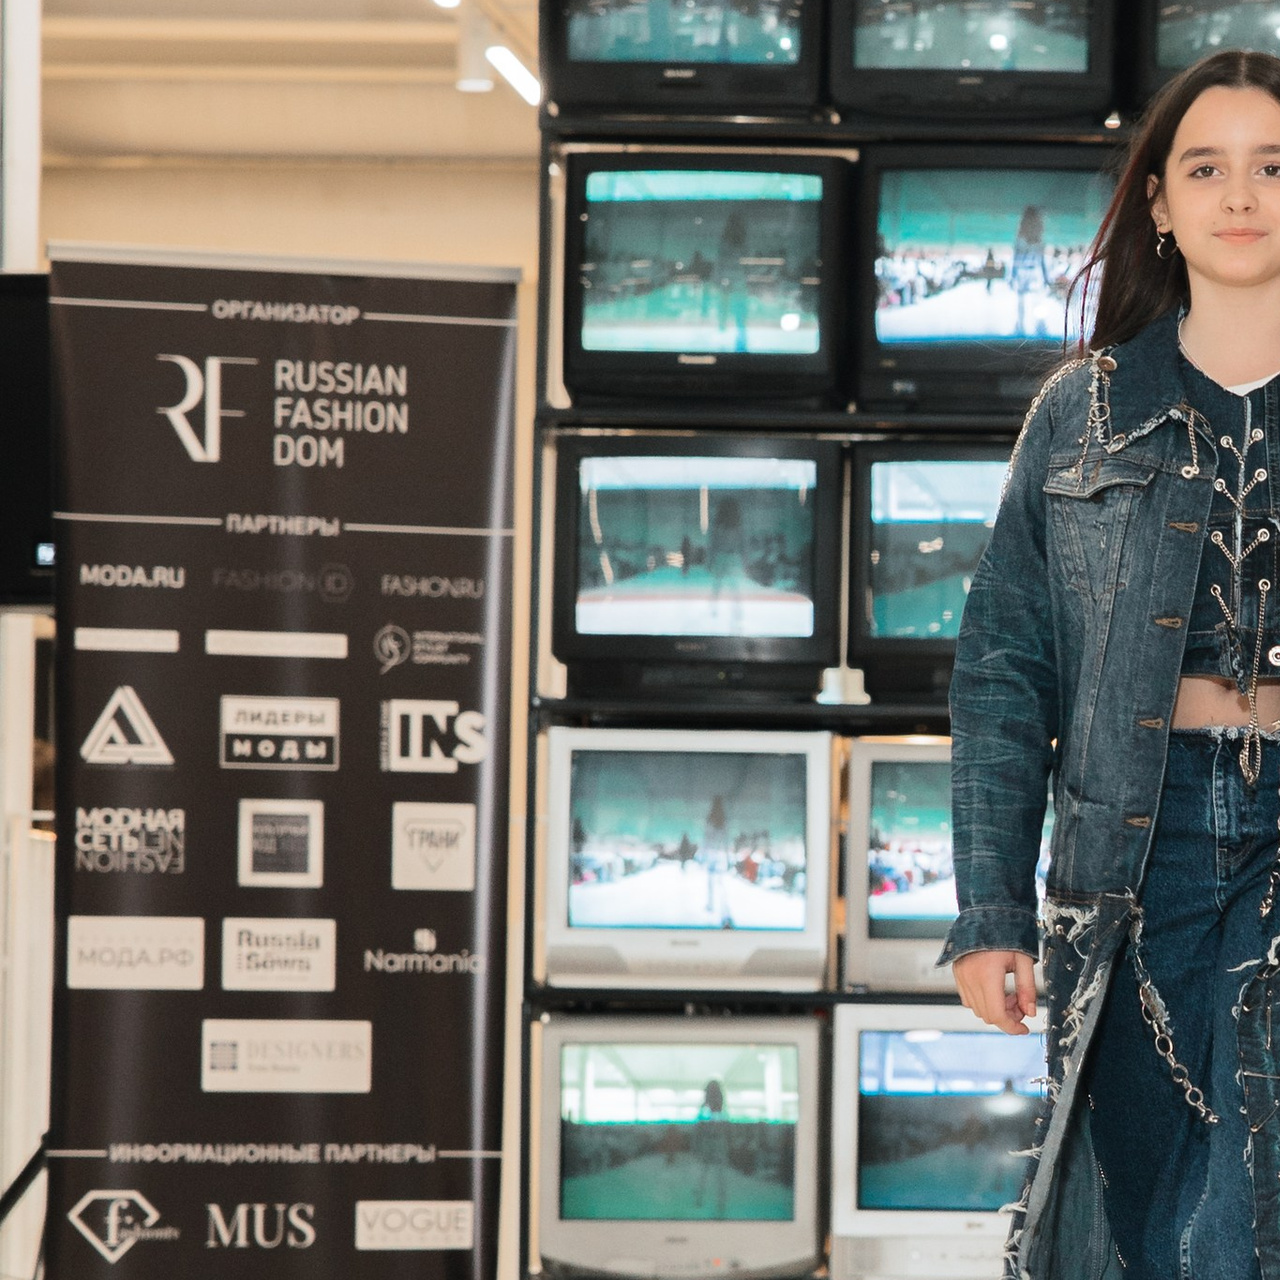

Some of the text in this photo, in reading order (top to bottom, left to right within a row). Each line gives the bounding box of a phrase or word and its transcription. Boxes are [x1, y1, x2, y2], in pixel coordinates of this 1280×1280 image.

[212, 299, 361, 325] ОРГАНИЗАТОР
[274, 359, 408, 397] RUSSIAN
[274, 397, 408, 433] FASHION
[274, 435, 345, 468] DOM
[226, 513, 340, 536] ПАРТНЕРЫ
[81, 565, 185, 589] MODA.RU
[233, 708, 327, 727] ЛИДЕРЫ
[232, 738, 328, 761] МОДЫ
[78, 946, 195, 970] МОДА.РФ
[109, 1143, 437, 1166] ИНФОРМАЦИОННЫЕ ПАРТНЕРЫ
[206, 1203, 316, 1248] MUS
[361, 1207, 468, 1233] VOGUE
